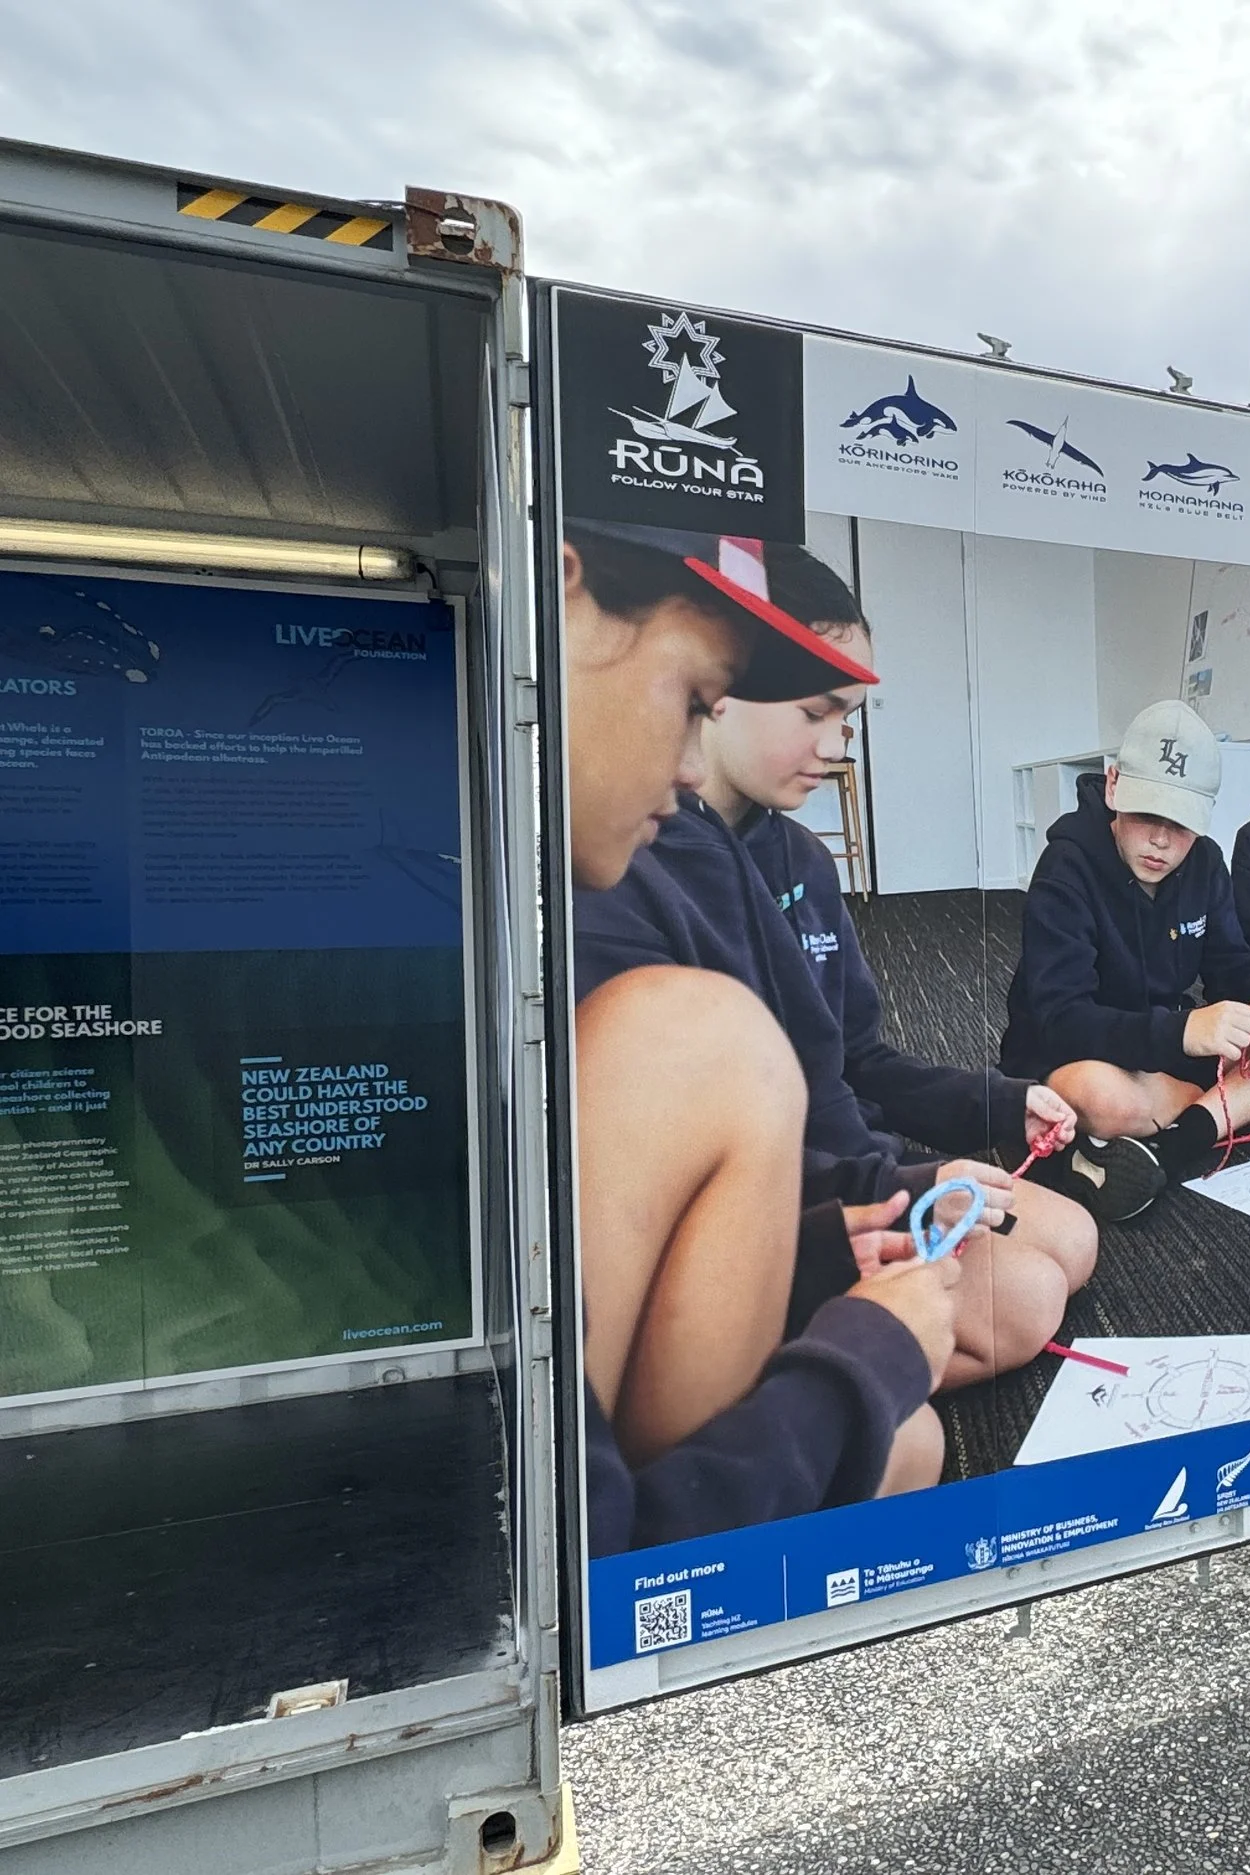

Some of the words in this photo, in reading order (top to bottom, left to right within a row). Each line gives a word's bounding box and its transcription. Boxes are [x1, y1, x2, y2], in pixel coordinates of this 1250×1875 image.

[839, 443, 958, 471] KŌRINORINO
[838, 457, 861, 466] OUR
[932, 471, 959, 480] WAKE
[611, 474, 677, 490] FOLLOW
[681, 484, 722, 497] YOUR
[726, 489, 764, 503] STAR
[1003, 469, 1106, 494] KŌKŌKAHA
[1003, 483, 1057, 496] POWERED
[1080, 494, 1106, 503] WIND
[1139, 490, 1244, 513] MOANAMANA
[1178, 507, 1209, 517] BLUE
[1216, 512, 1244, 521] BELT
[353, 649, 427, 661] FOUNDATION
[140, 727, 184, 738] TOROA
[194, 730, 224, 740] Since
[24, 1006, 68, 1022] FOR
[72, 1004, 112, 1020] THE
[51, 1020, 163, 1039] SEASHORE
[10, 1069, 50, 1079] citizen
[52, 1067, 95, 1077] science
[241, 1068, 290, 1086] NEW
[295, 1063, 389, 1083] ZEALAND
[22, 1079, 71, 1090] children
[74, 1079, 87, 1088] to
[242, 1084, 312, 1104] COULD
[317, 1081, 369, 1099] HAVE
[373, 1079, 408, 1096] THE
[54, 1089, 110, 1102] collecting
[48, 1103, 71, 1113] and
[75, 1102, 83, 1111] it
[85, 1101, 107, 1113] just
[242, 1104, 290, 1122] BEST
[295, 1096, 427, 1118] UNDERSTOOD
[243, 1117, 350, 1139] SEASHORE
[354, 1116, 381, 1132] OF
[243, 1139, 288, 1157] ANY
[291, 1132, 386, 1154] COUNTRY
[22, 1150, 61, 1160] Zealand
[59, 1158, 104, 1169] Auckland
[244, 1161, 260, 1170] DR
[262, 1159, 295, 1170] SALLY
[297, 1155, 340, 1166] CARSON
[342, 1319, 443, 1341] liveocean.com
[1001, 1527, 1042, 1543] MINISTRY
[1043, 1523, 1054, 1533] OF
[1001, 1535, 1054, 1553] INNOVATION
[1055, 1532, 1062, 1540] &
[1063, 1518, 1119, 1539] EMPLOYMENT
[635, 1573, 664, 1591] Find
[666, 1568, 689, 1583] out
[691, 1561, 725, 1578] more
[863, 1568, 875, 1578] Te
